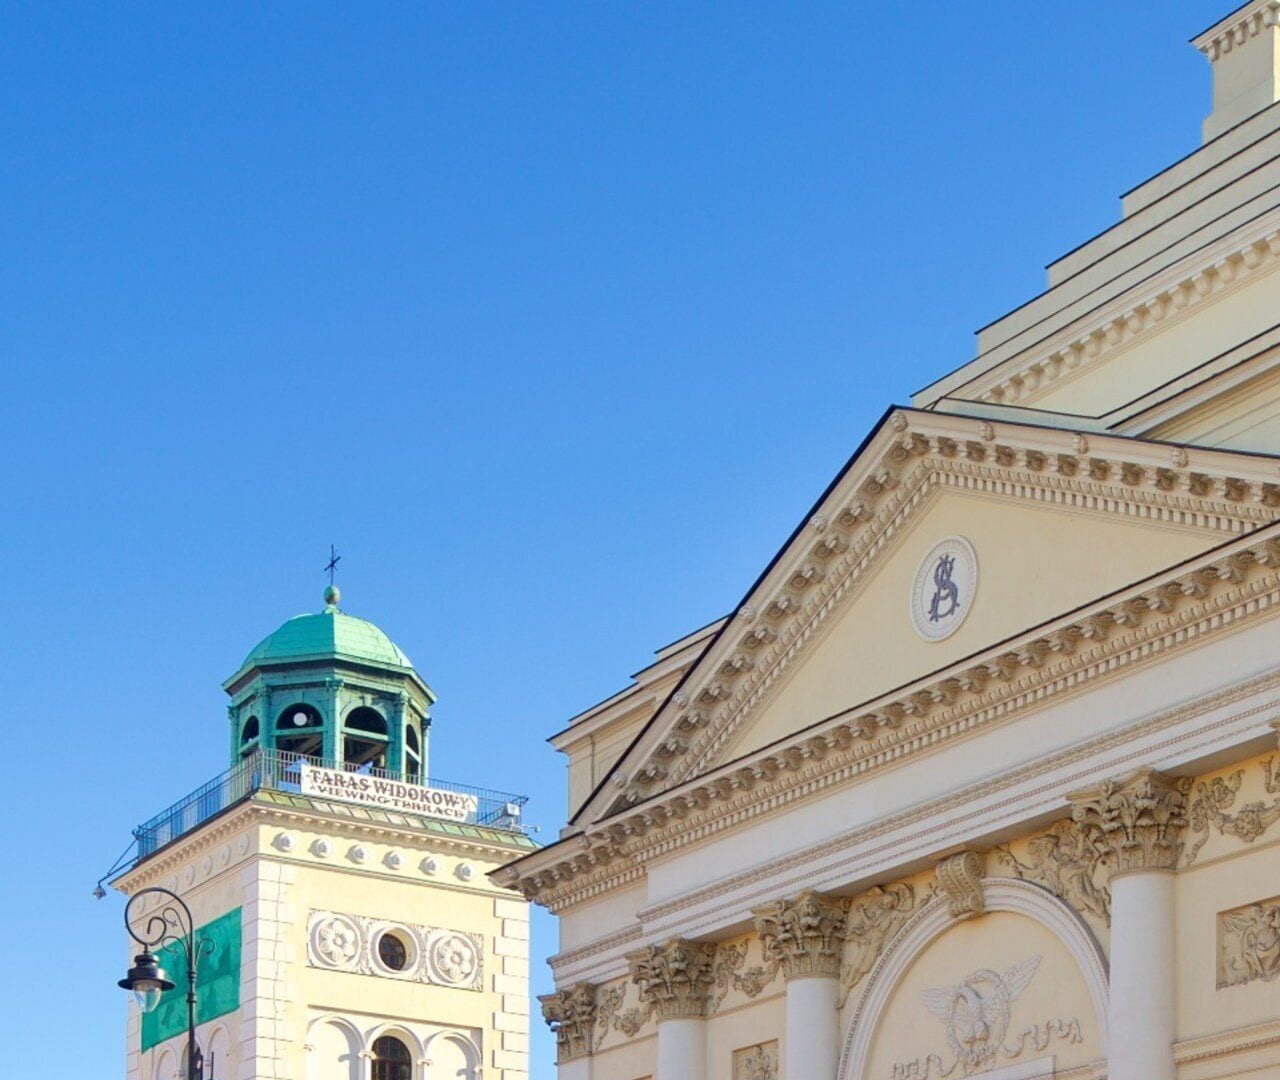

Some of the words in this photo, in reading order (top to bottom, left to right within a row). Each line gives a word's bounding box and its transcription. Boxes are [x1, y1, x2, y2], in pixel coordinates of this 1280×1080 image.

[310, 770, 371, 792] TARAS
[373, 780, 471, 810] WIDOKOWY
[316, 786, 389, 804] VIEWING
[391, 799, 465, 819] TERRACE
